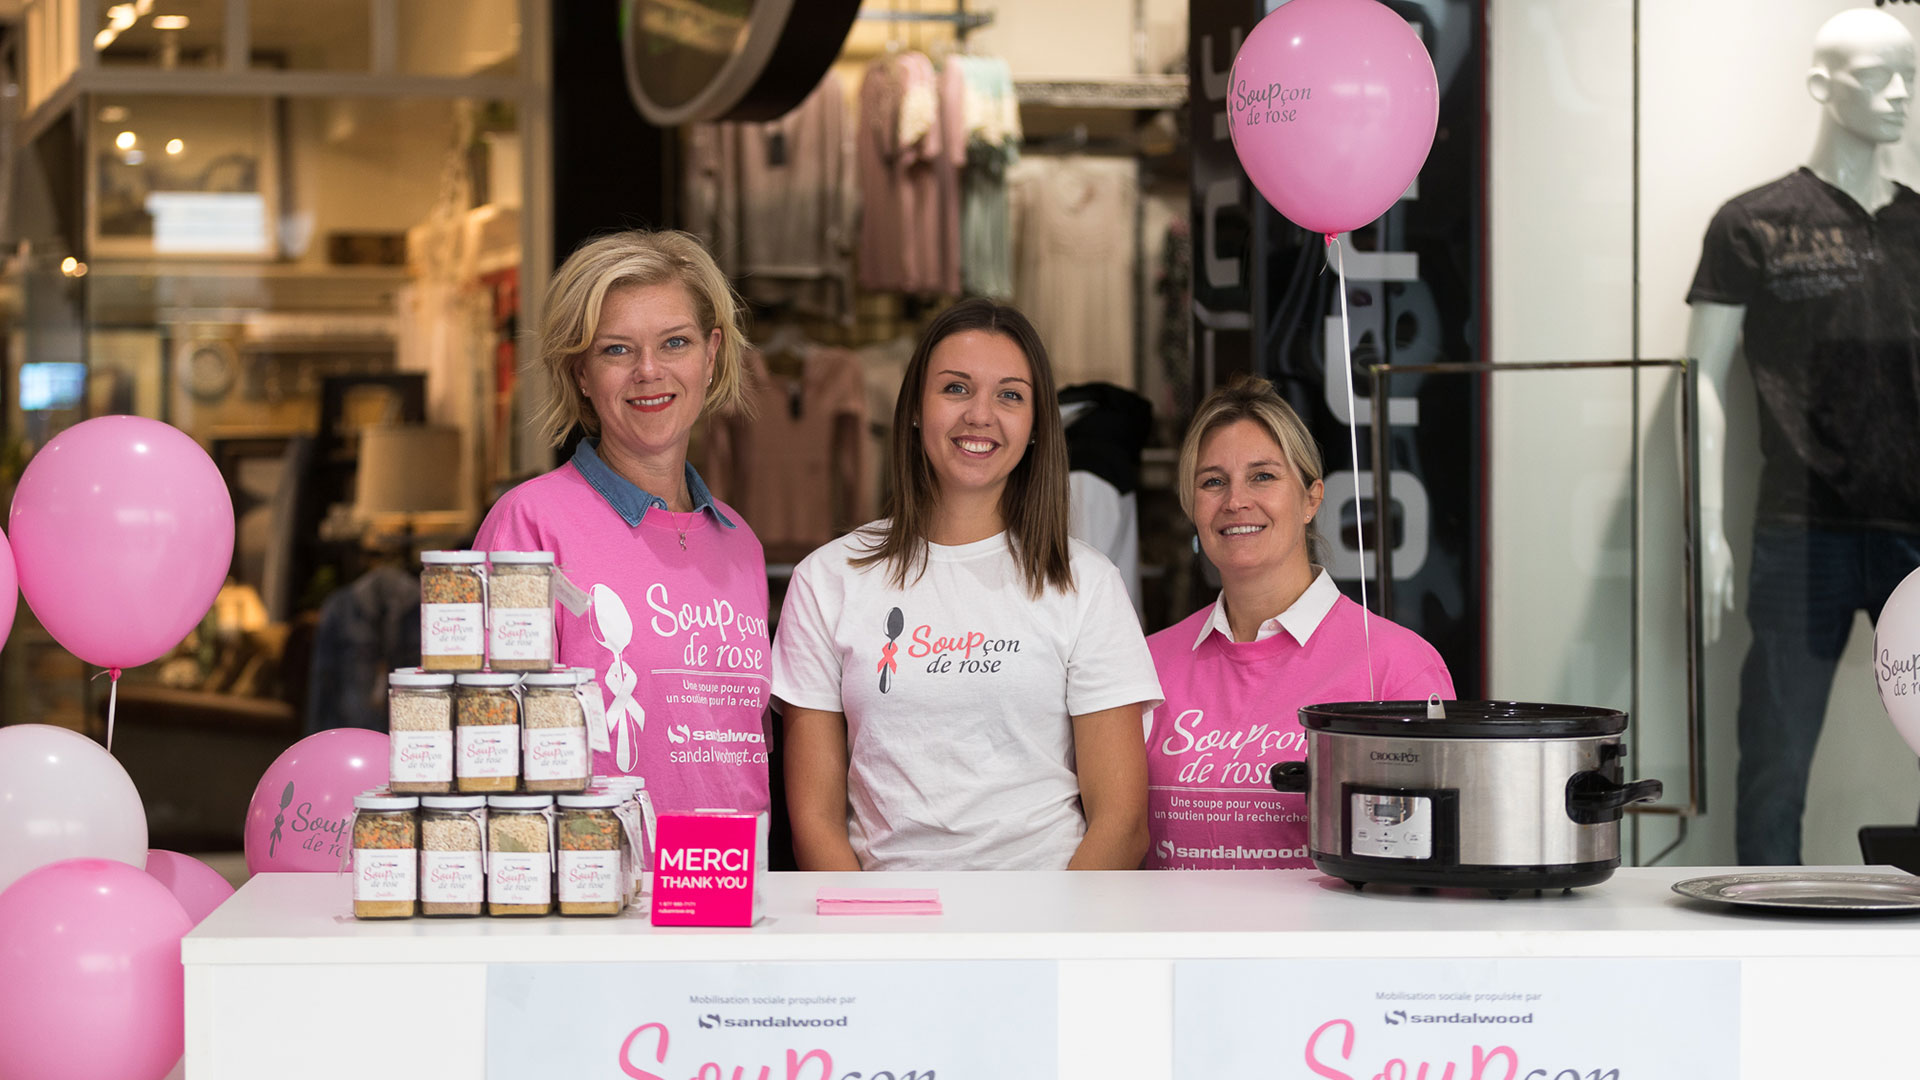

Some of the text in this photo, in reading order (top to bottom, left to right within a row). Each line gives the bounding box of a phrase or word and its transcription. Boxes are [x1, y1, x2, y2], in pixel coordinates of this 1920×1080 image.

[1236, 80, 1311, 112] Soupçon
[1247, 105, 1296, 126] de rose
[646, 583, 768, 641] Soupçon
[908, 625, 1021, 659] Soupçon
[684, 632, 763, 669] de rose
[926, 654, 1001, 674] de rose
[683, 680, 698, 691] Une
[720, 684, 745, 695] pour
[1894, 676, 1907, 696] de
[666, 695, 679, 703] un
[709, 697, 725, 707] pour
[727, 695, 736, 706] la
[1178, 753, 1214, 783] de
[1170, 796, 1285, 811] Une soupe pour vous,
[1155, 810, 1308, 823] un soutien pour la recherche
[302, 834, 323, 852] de
[660, 848, 748, 871] MERCI
[1176, 844, 1308, 859] sandalwood
[661, 876, 747, 889] THANK YOU
[689, 995, 856, 1006] Mobilisation sociale propulsée par
[1375, 992, 1542, 1002] Mobilisation sociale propulsée par
[724, 1016, 848, 1027] sandalwood
[1410, 1013, 1533, 1024] sandalwood
